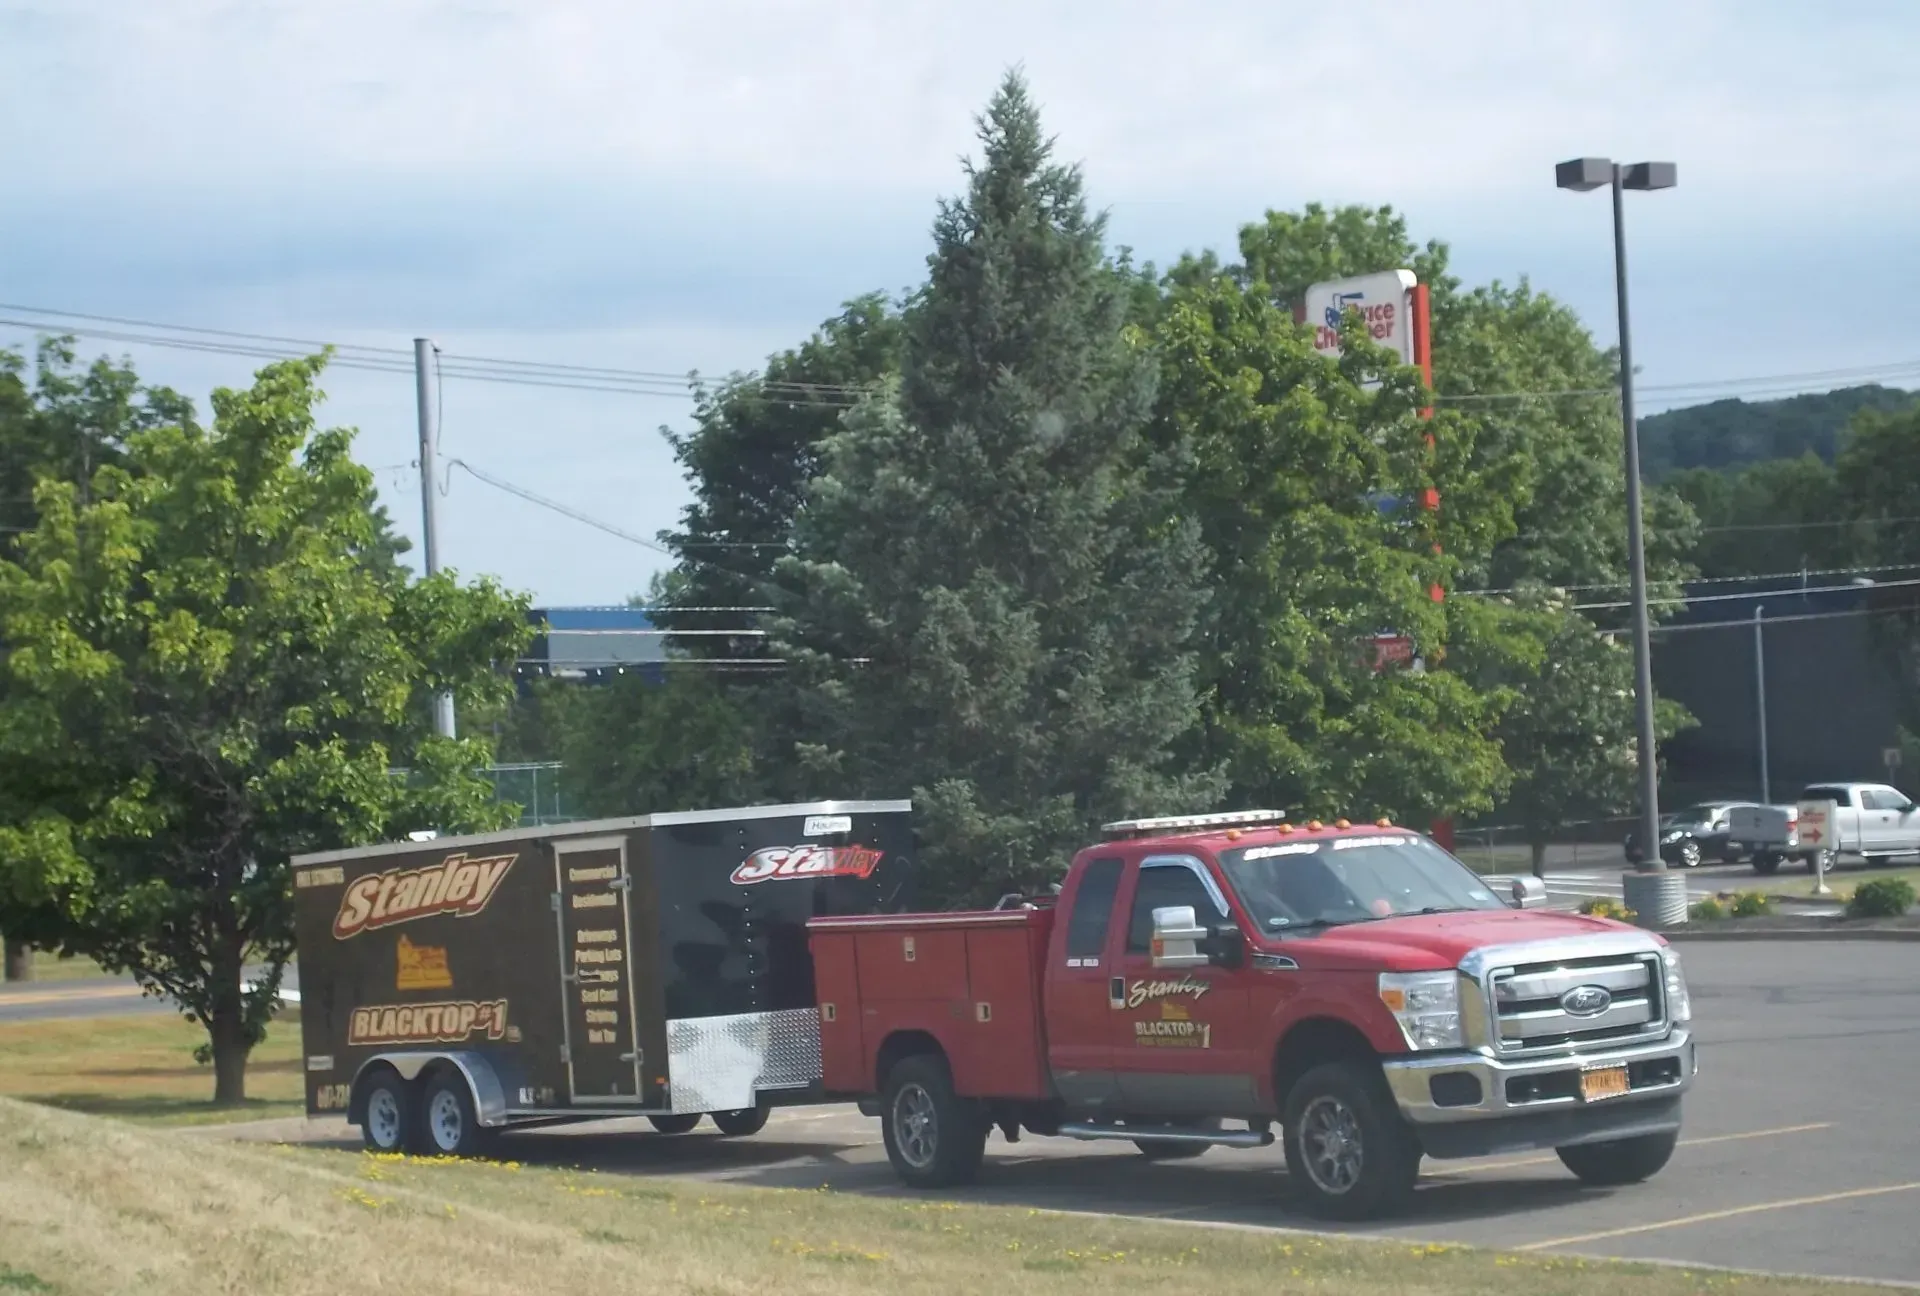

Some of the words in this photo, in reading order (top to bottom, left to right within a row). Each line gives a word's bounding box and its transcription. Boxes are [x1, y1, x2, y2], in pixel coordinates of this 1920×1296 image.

[1313, 321, 1394, 350] Cher
[336, 855, 513, 933] Stanley
[1128, 974, 1210, 1008] Stanley
[351, 1002, 477, 1041] BLACKTOP
[1135, 1021, 1194, 1036] BLACKTOP
